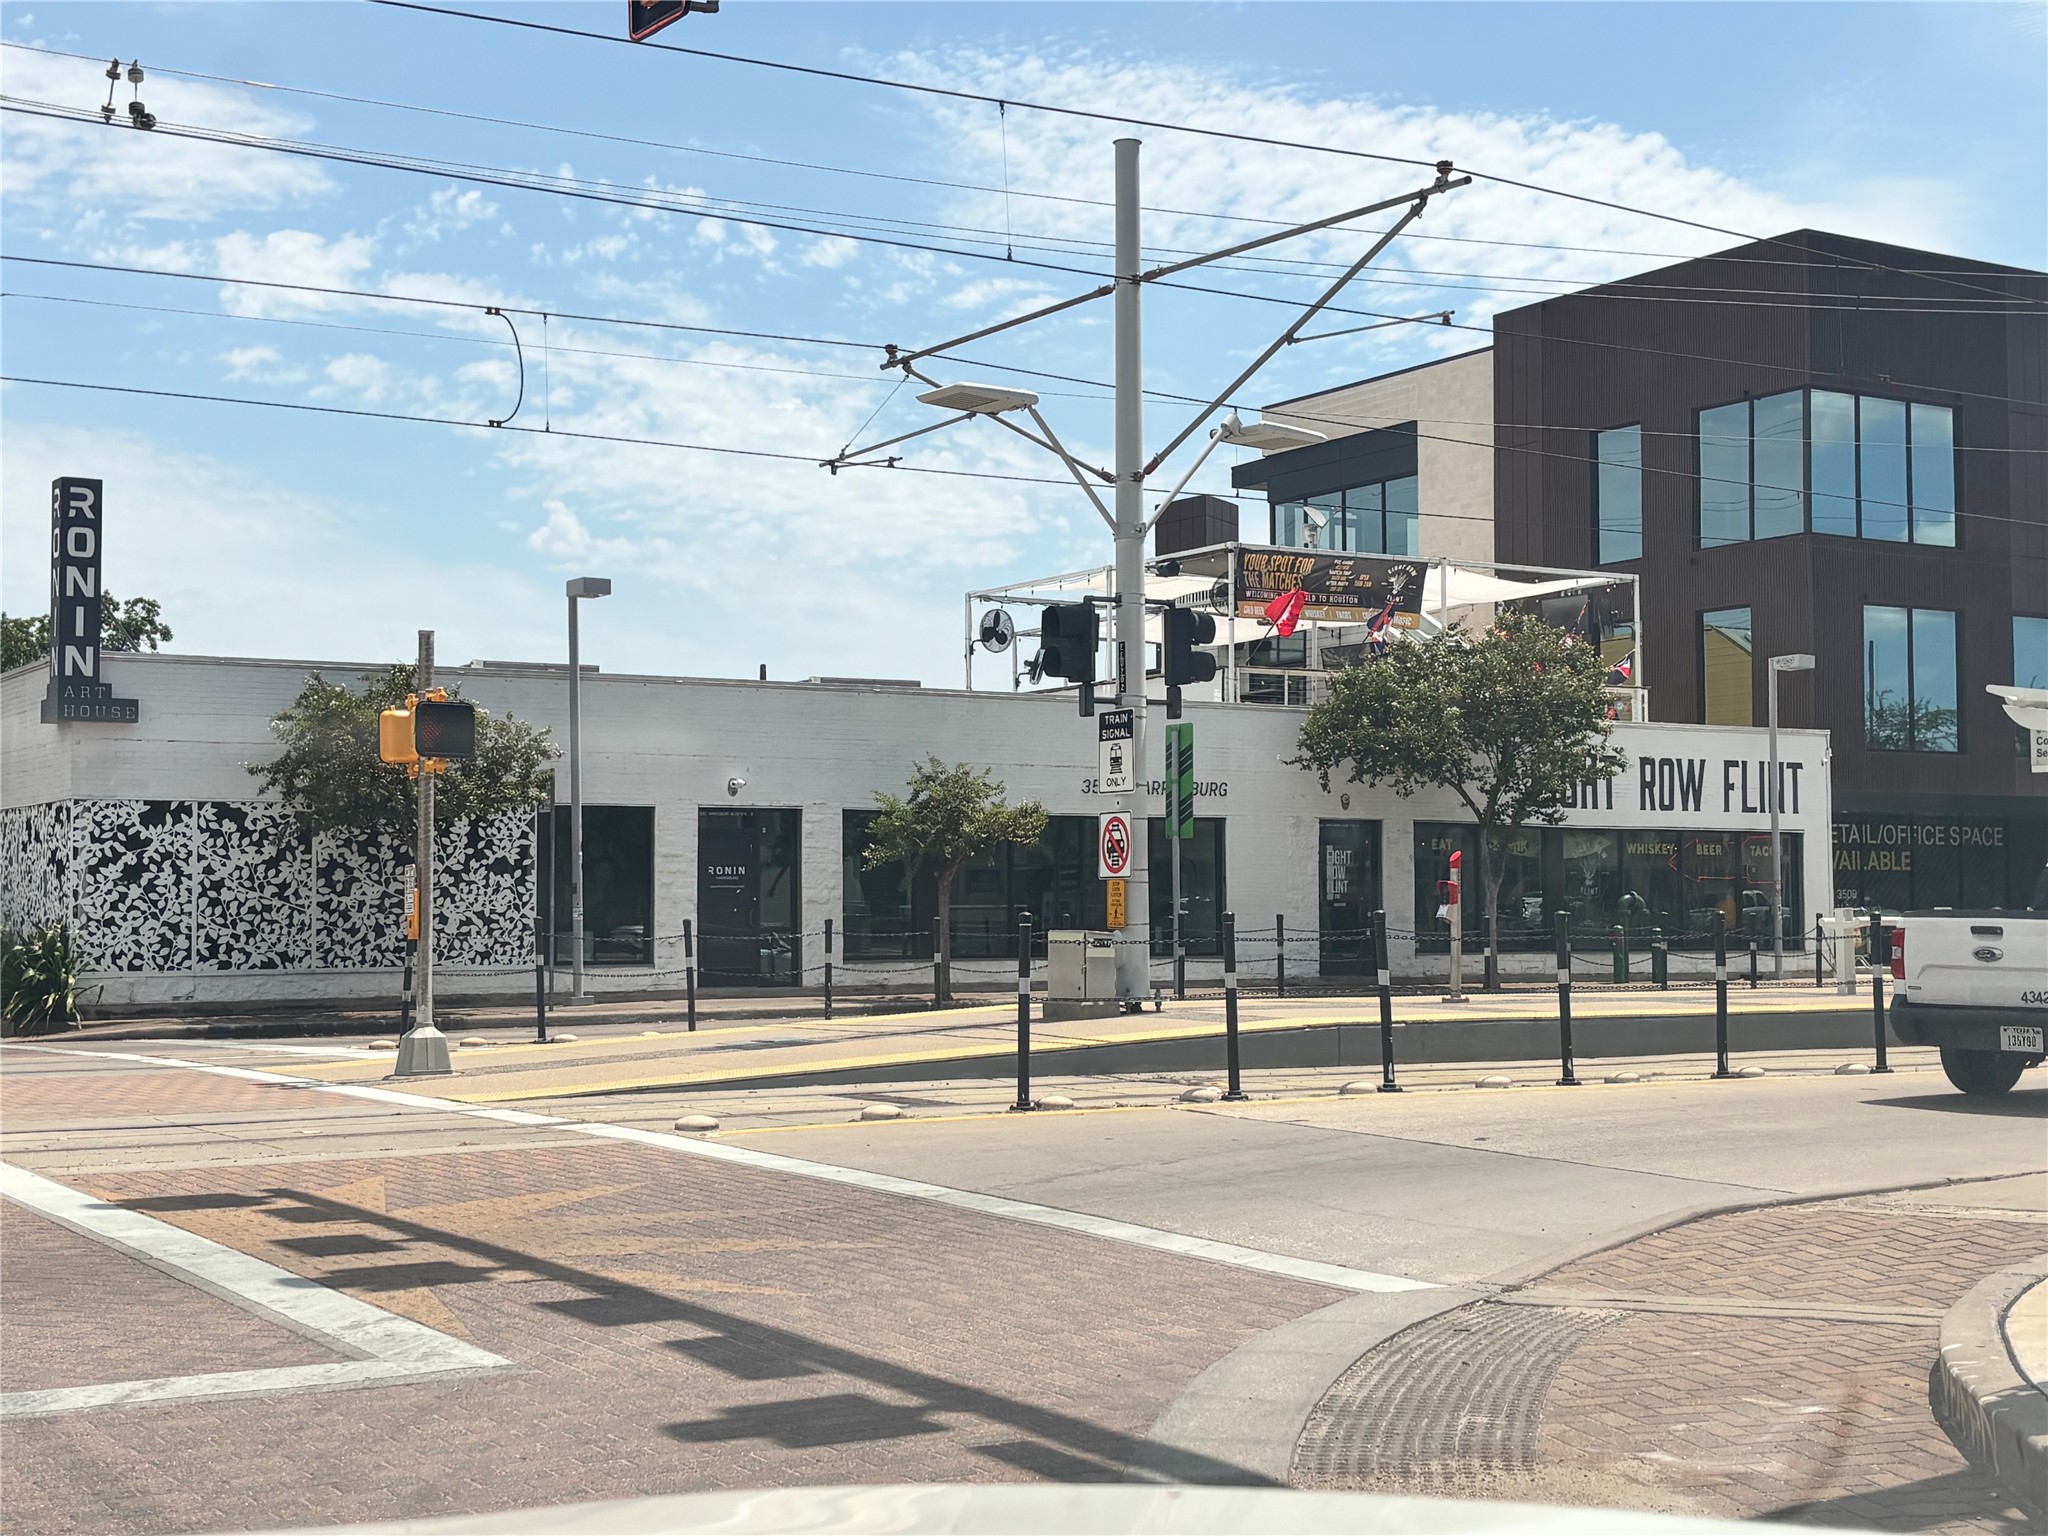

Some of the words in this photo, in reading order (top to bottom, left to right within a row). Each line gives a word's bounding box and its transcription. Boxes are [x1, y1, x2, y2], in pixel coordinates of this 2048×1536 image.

[1244, 552, 1269, 571] YOUR
[1269, 555, 1296, 572] SPOT
[1294, 557, 1315, 574] FOR
[51, 487, 61, 678] RONIN
[65, 486, 96, 677] RONIN
[1243, 570, 1261, 588] THE
[1261, 570, 1304, 590] MATCHES
[1320, 595, 1327, 603] TO
[1329, 595, 1359, 604] HOUSTON
[64, 685, 105, 699] ART
[63, 704, 136, 720] HOUSE
[1105, 713, 1128, 725] TRAIN
[1102, 728, 1131, 740] SIGNAL
[1106, 776, 1127, 787] ONLY
[1639, 756, 1706, 811] ROW
[1832, 823, 1945, 846] ETAIL/OFFICE
[1949, 826, 2003, 846] SPACE
[1431, 838, 1453, 850] EAT
[1626, 842, 1675, 855] WHISKEY
[1696, 844, 1722, 856] BEER
[1833, 850, 1912, 871] VAILABLE
[708, 866, 746, 875] RONIN
[1836, 889, 1858, 900] 3509
